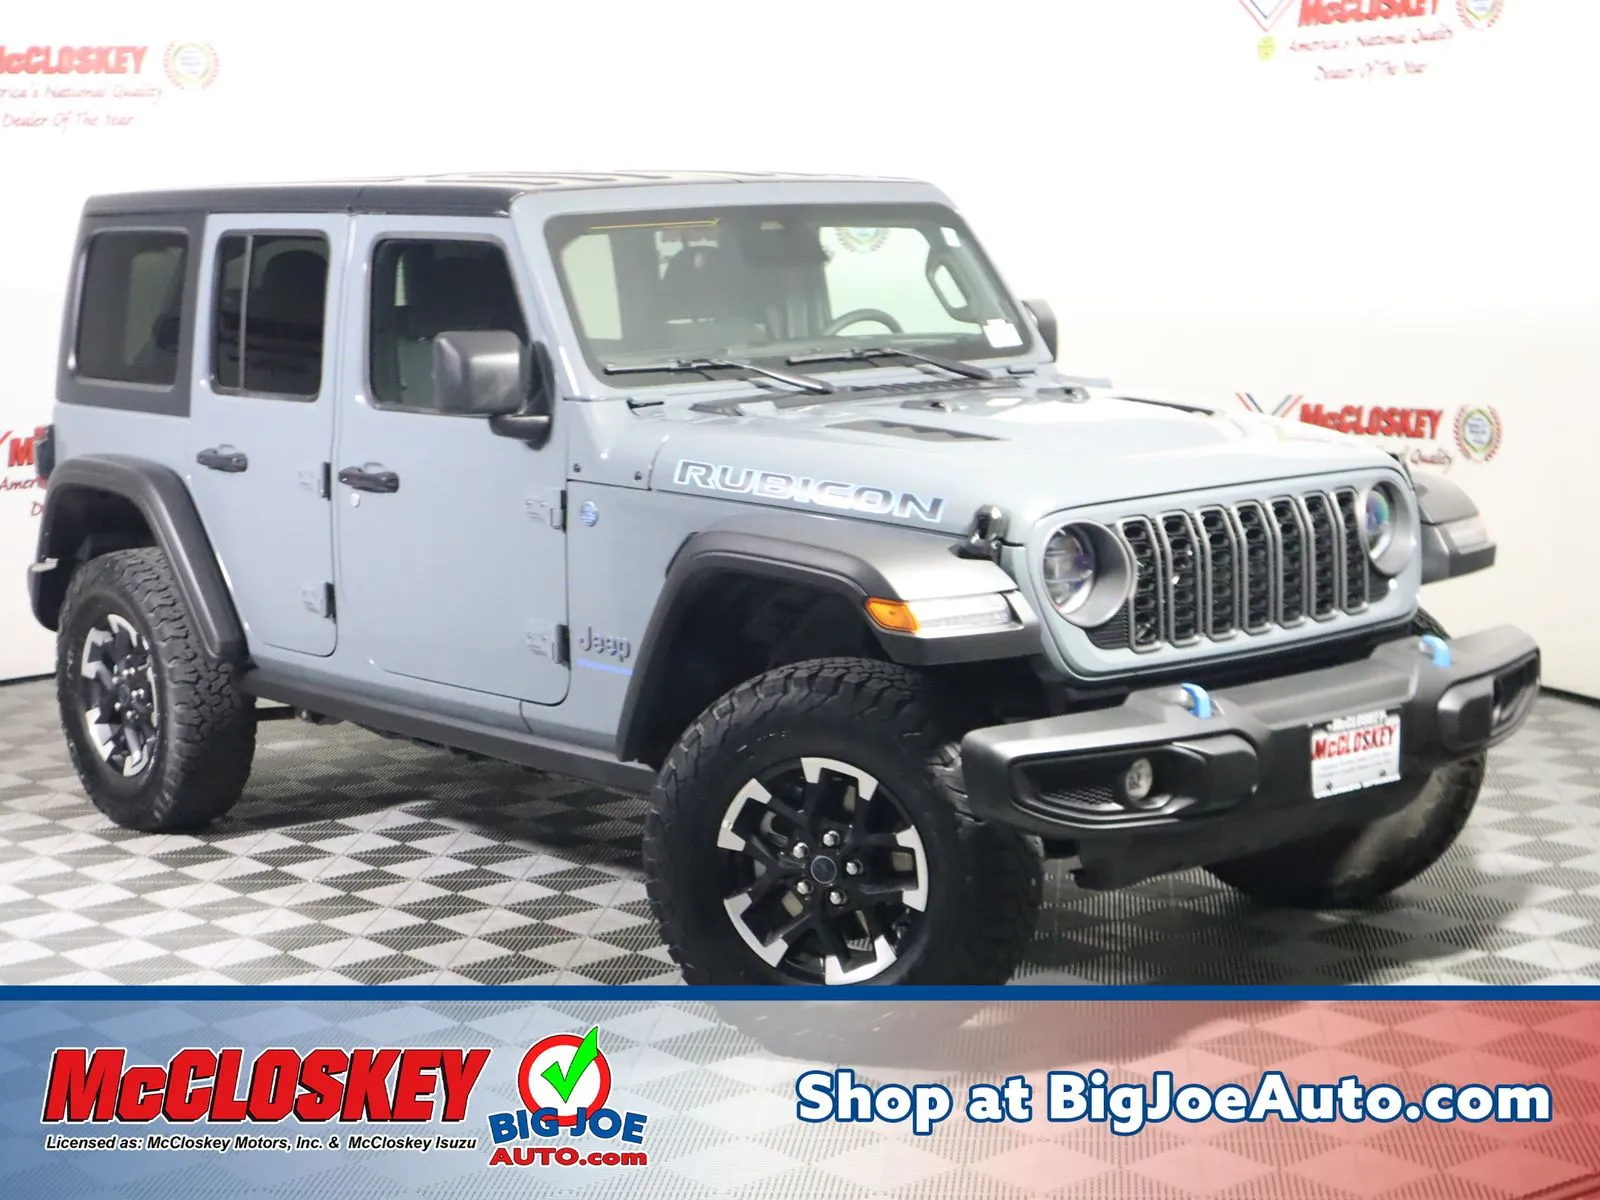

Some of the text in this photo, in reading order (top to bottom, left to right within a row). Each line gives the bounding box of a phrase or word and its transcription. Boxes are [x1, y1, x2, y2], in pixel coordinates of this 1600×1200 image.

[1299, 403, 1443, 439] McCLOSKEY
[673, 459, 944, 524] RUBICON
[579, 626, 631, 663] Jeep
[1311, 725, 1396, 761] McCLOSKEY
